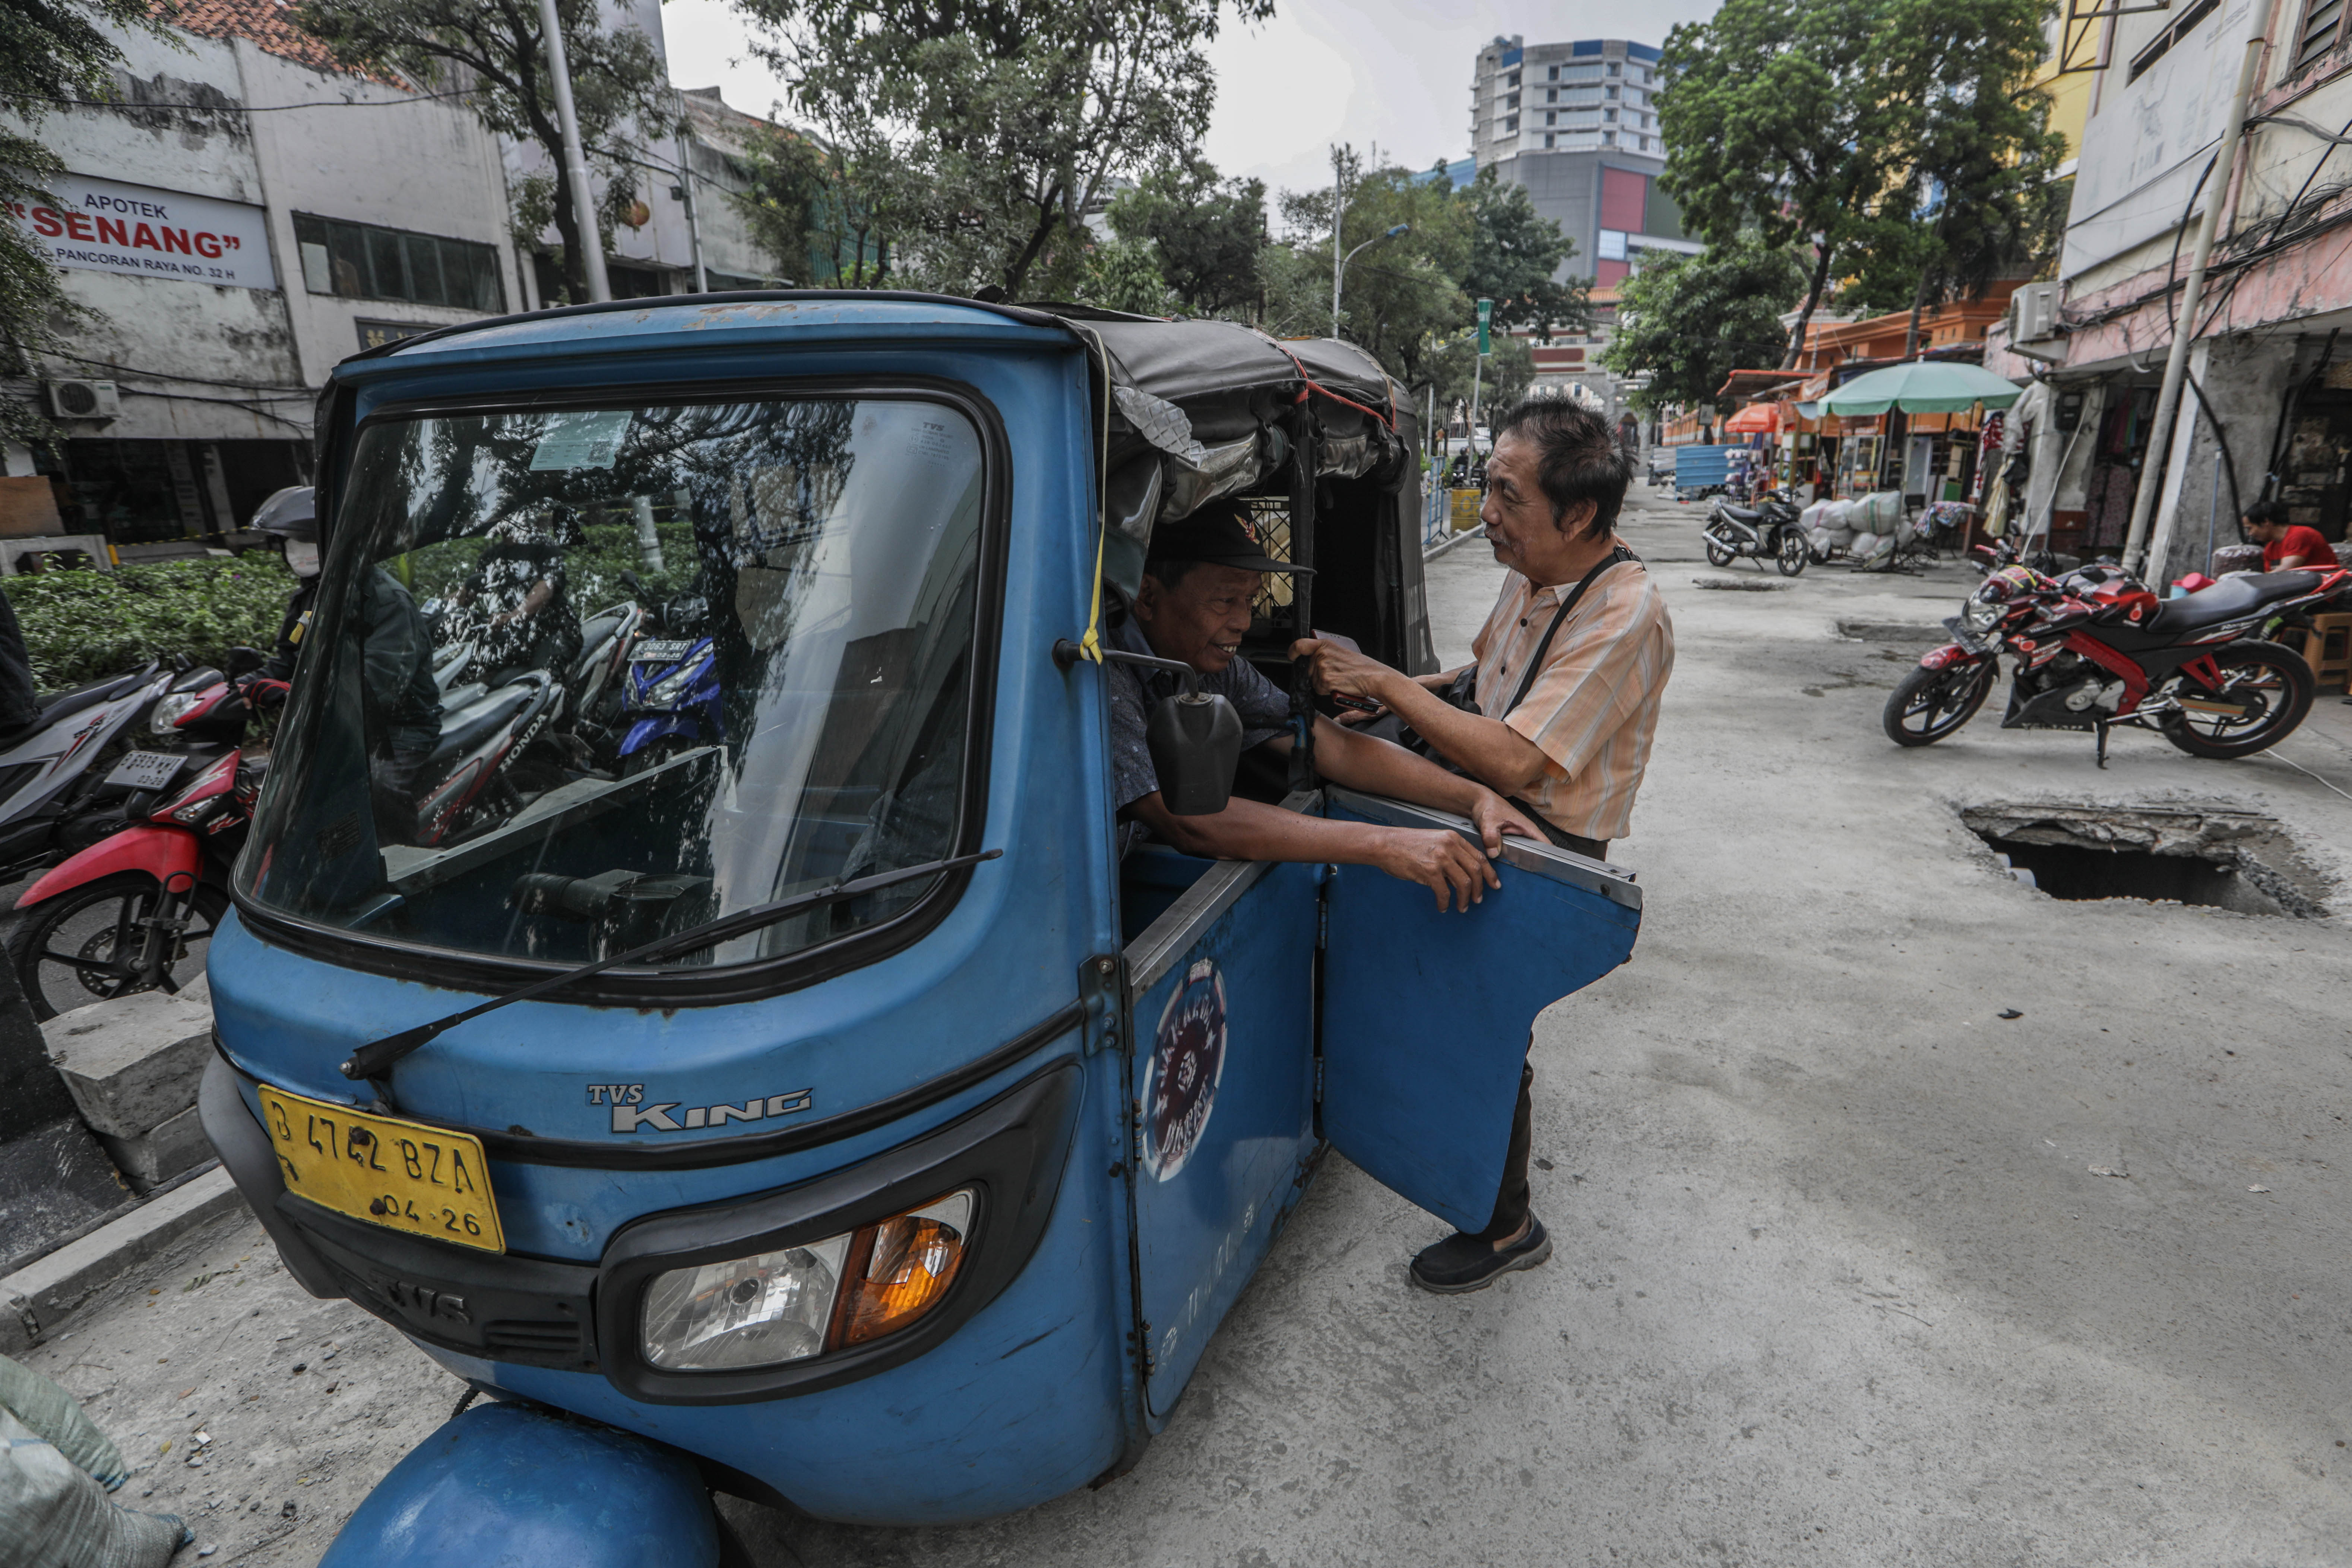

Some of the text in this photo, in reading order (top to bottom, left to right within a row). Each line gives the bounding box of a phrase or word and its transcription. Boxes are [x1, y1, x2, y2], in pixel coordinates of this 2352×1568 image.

[85, 194, 168, 220] APOTEK
[56, 248, 140, 268] PANCORAN
[145, 259, 180, 274] RAYA
[183, 264, 206, 277] NO.
[209, 267, 223, 279] 32
[226, 269, 235, 280] H
[923, 422, 945, 431] TVS
[498, 714, 548, 773] HONDA
[587, 1083, 645, 1106] TVS
[308, 1114, 386, 1172] 4742
[401, 1138, 475, 1194] BZA
[370, 1270, 474, 1325] TVS
